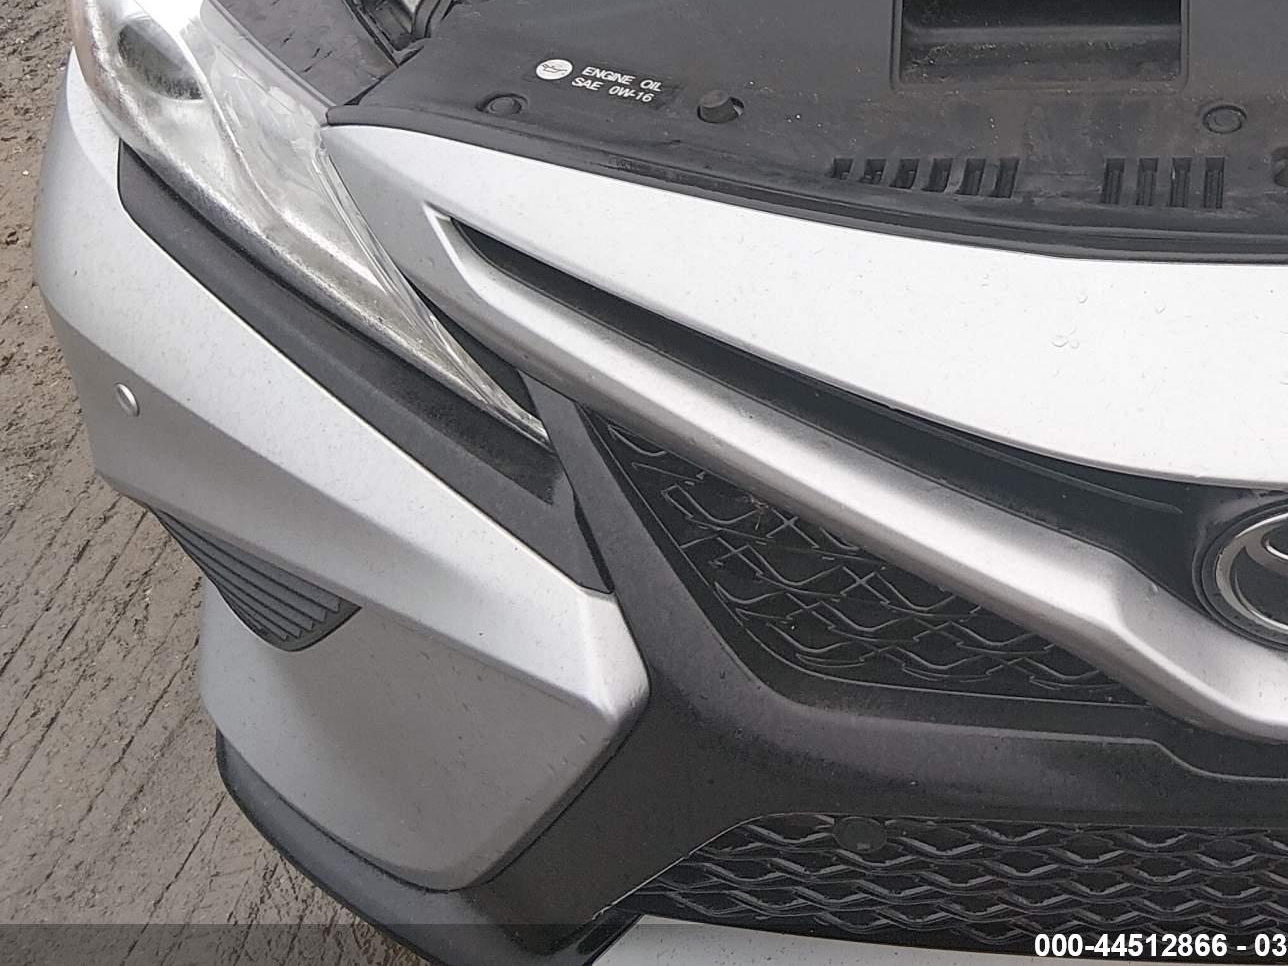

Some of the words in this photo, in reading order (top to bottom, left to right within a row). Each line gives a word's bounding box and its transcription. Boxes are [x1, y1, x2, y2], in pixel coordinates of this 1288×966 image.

[571, 77, 604, 91] SAE
[608, 85, 655, 102] 0W-16
[582, 66, 636, 85] ENGINE
[640, 79, 661, 92] OIL
